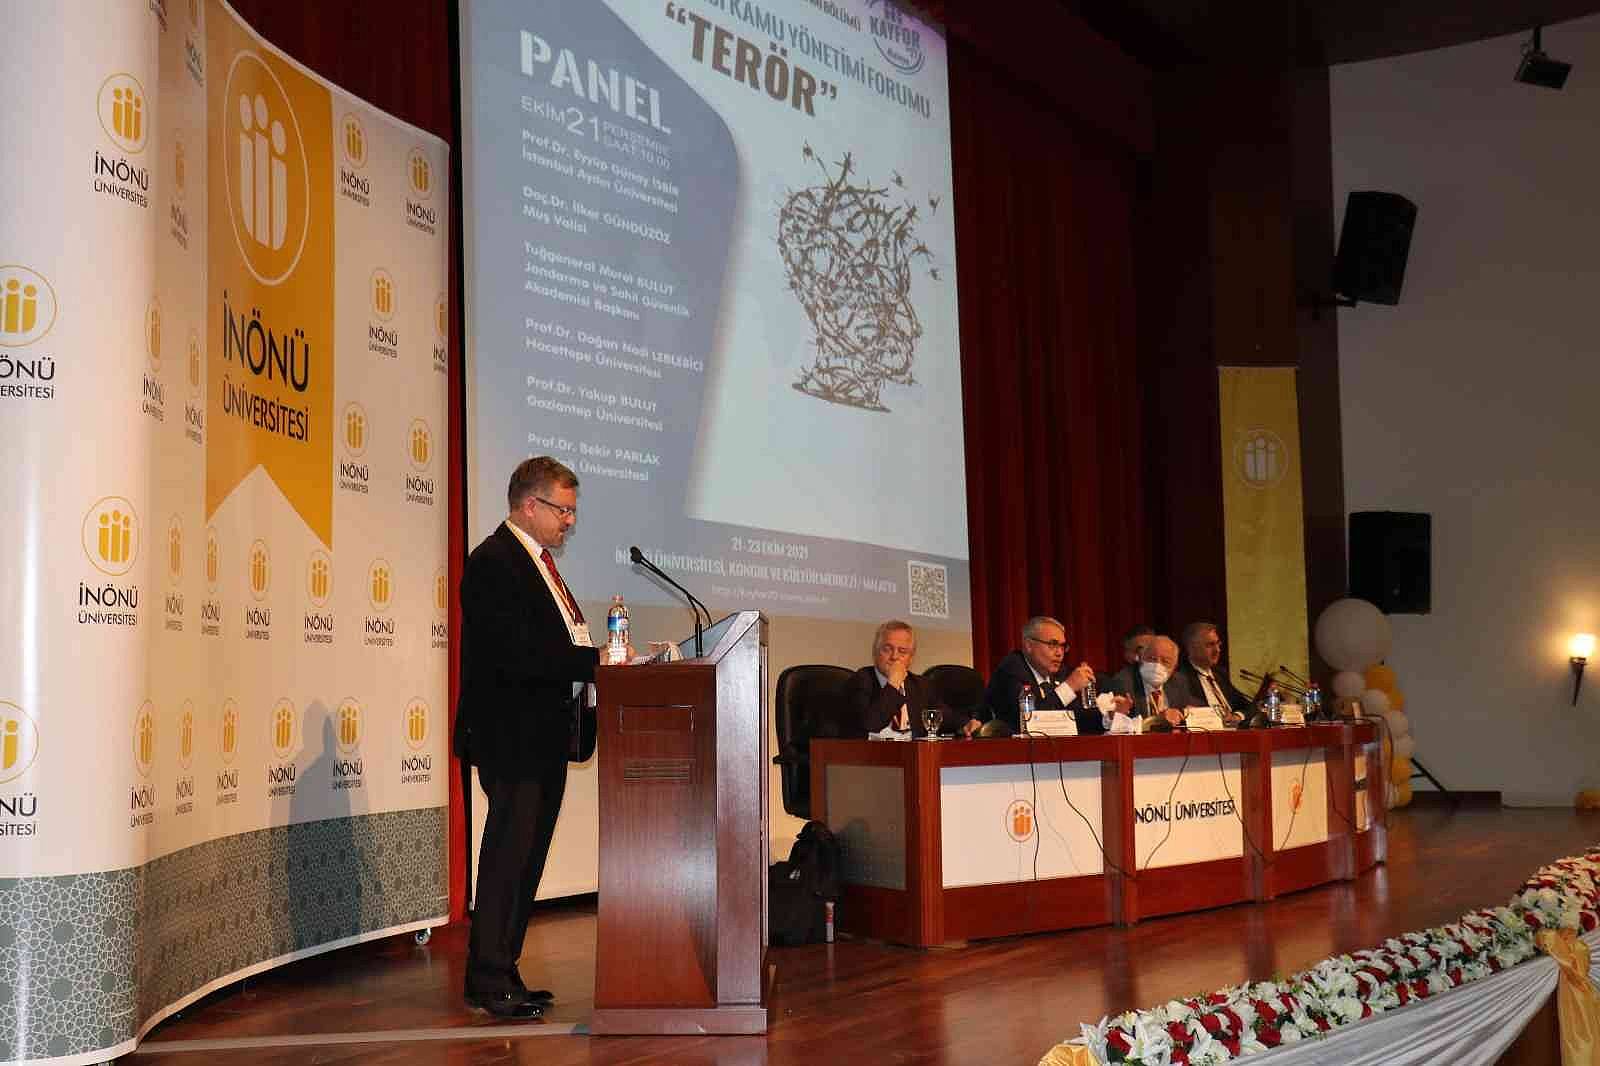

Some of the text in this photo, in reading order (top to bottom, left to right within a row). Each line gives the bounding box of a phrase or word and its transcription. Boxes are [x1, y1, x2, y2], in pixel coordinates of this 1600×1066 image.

[729, 0, 931, 119] KAMU YÖNETİMİ FORUMU
[519, 29, 673, 135] PANEL
[565, 106, 600, 143] 21
[94, 151, 149, 191] İNÖNÜ
[223, 288, 310, 392] İNÖNÜ
[369, 324, 399, 347] İNÖNÜ
[595, 350, 663, 380] Üniversitesi
[578, 385, 617, 407] Yakup
[223, 374, 310, 442] ÜNİVERSİTESİ
[595, 407, 664, 433] Üniversitesi
[340, 460, 369, 483] İNÖNÜ
[579, 458, 650, 481] Üniversitesi
[405, 473, 435, 495] İNÖNÜ
[79, 582, 138, 609] İNÖNÜ
[78, 609, 138, 626] ÜNİVERSİTESİ
[246, 606, 270, 627] İNÖNÜ
[304, 611, 334, 632] İNÖNÜ
[364, 615, 395, 635] İNÖNÜ
[268, 763, 297, 785] İNÖNÜ
[332, 757, 364, 778] İNÖNÜ
[401, 754, 433, 773] İNÖNÜ
